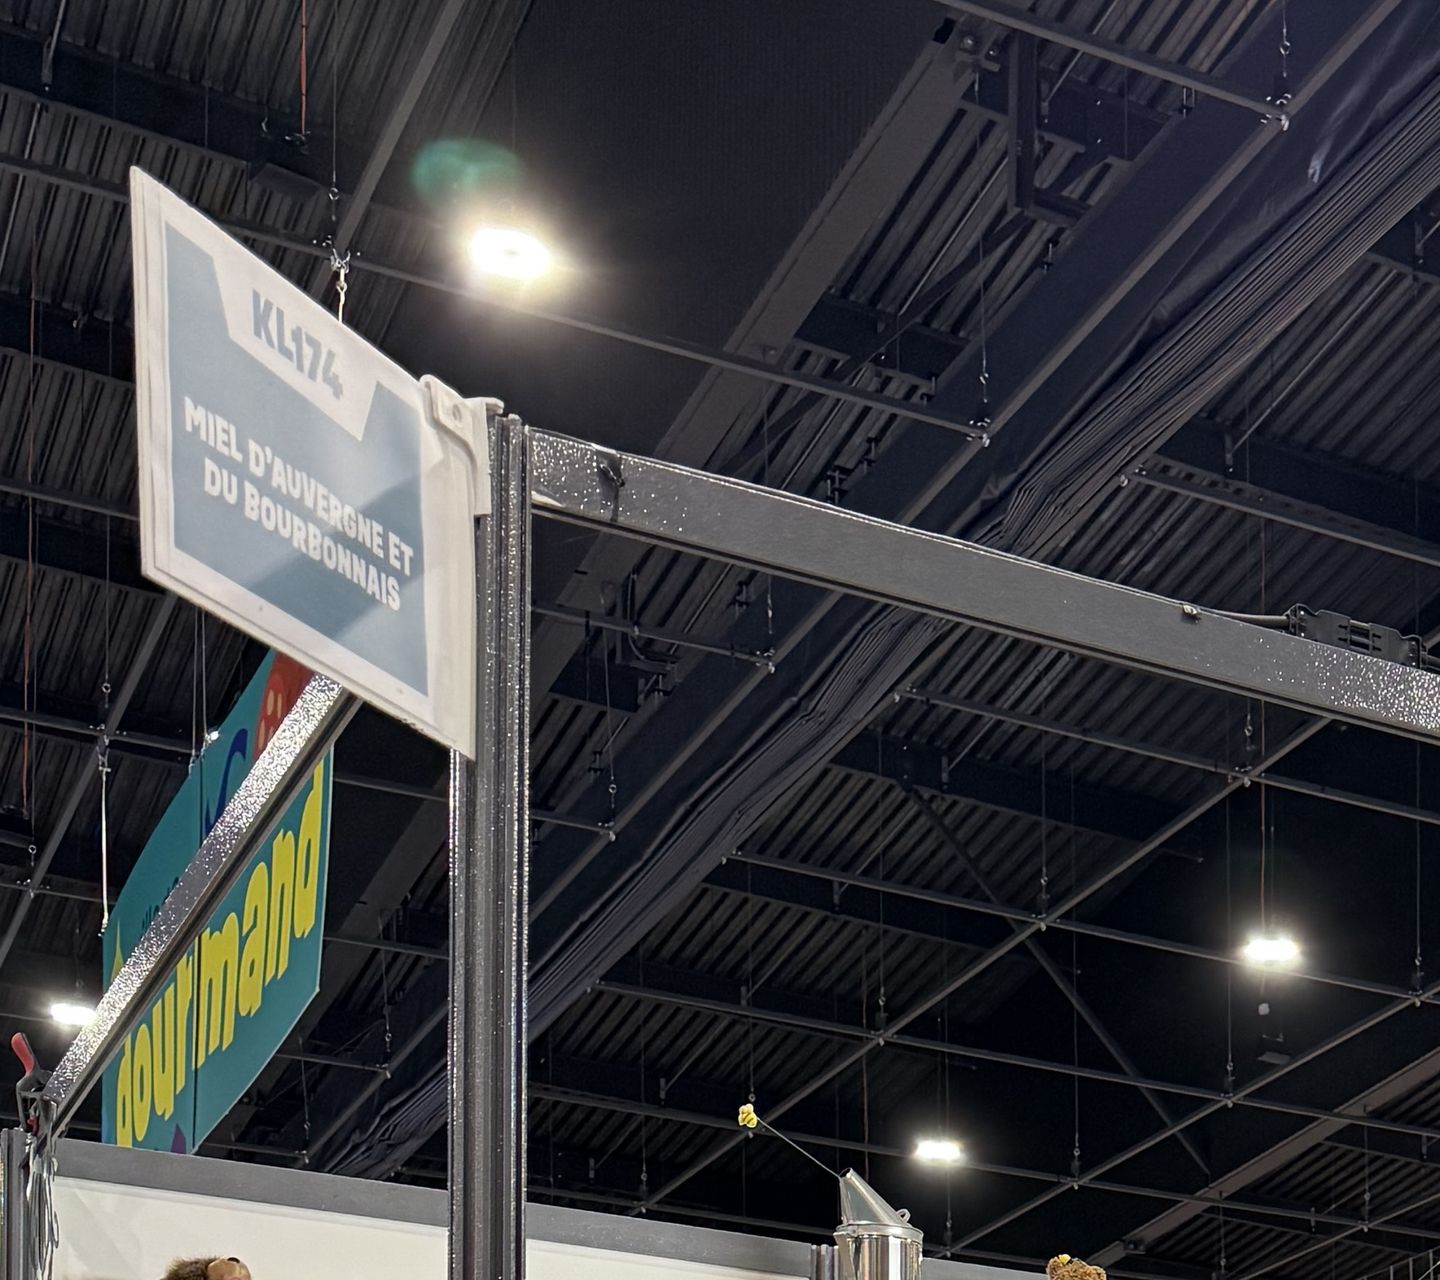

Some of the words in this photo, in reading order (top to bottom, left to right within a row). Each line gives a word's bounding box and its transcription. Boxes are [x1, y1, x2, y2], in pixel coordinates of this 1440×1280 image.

[252, 289, 343, 399] KL174
[185, 397, 243, 463] MIEL
[250, 439, 383, 557] D'AUVERGNE
[389, 532, 412, 576] ET
[204, 457, 237, 505] DU
[245, 480, 400, 611] BOURBONNAIS
